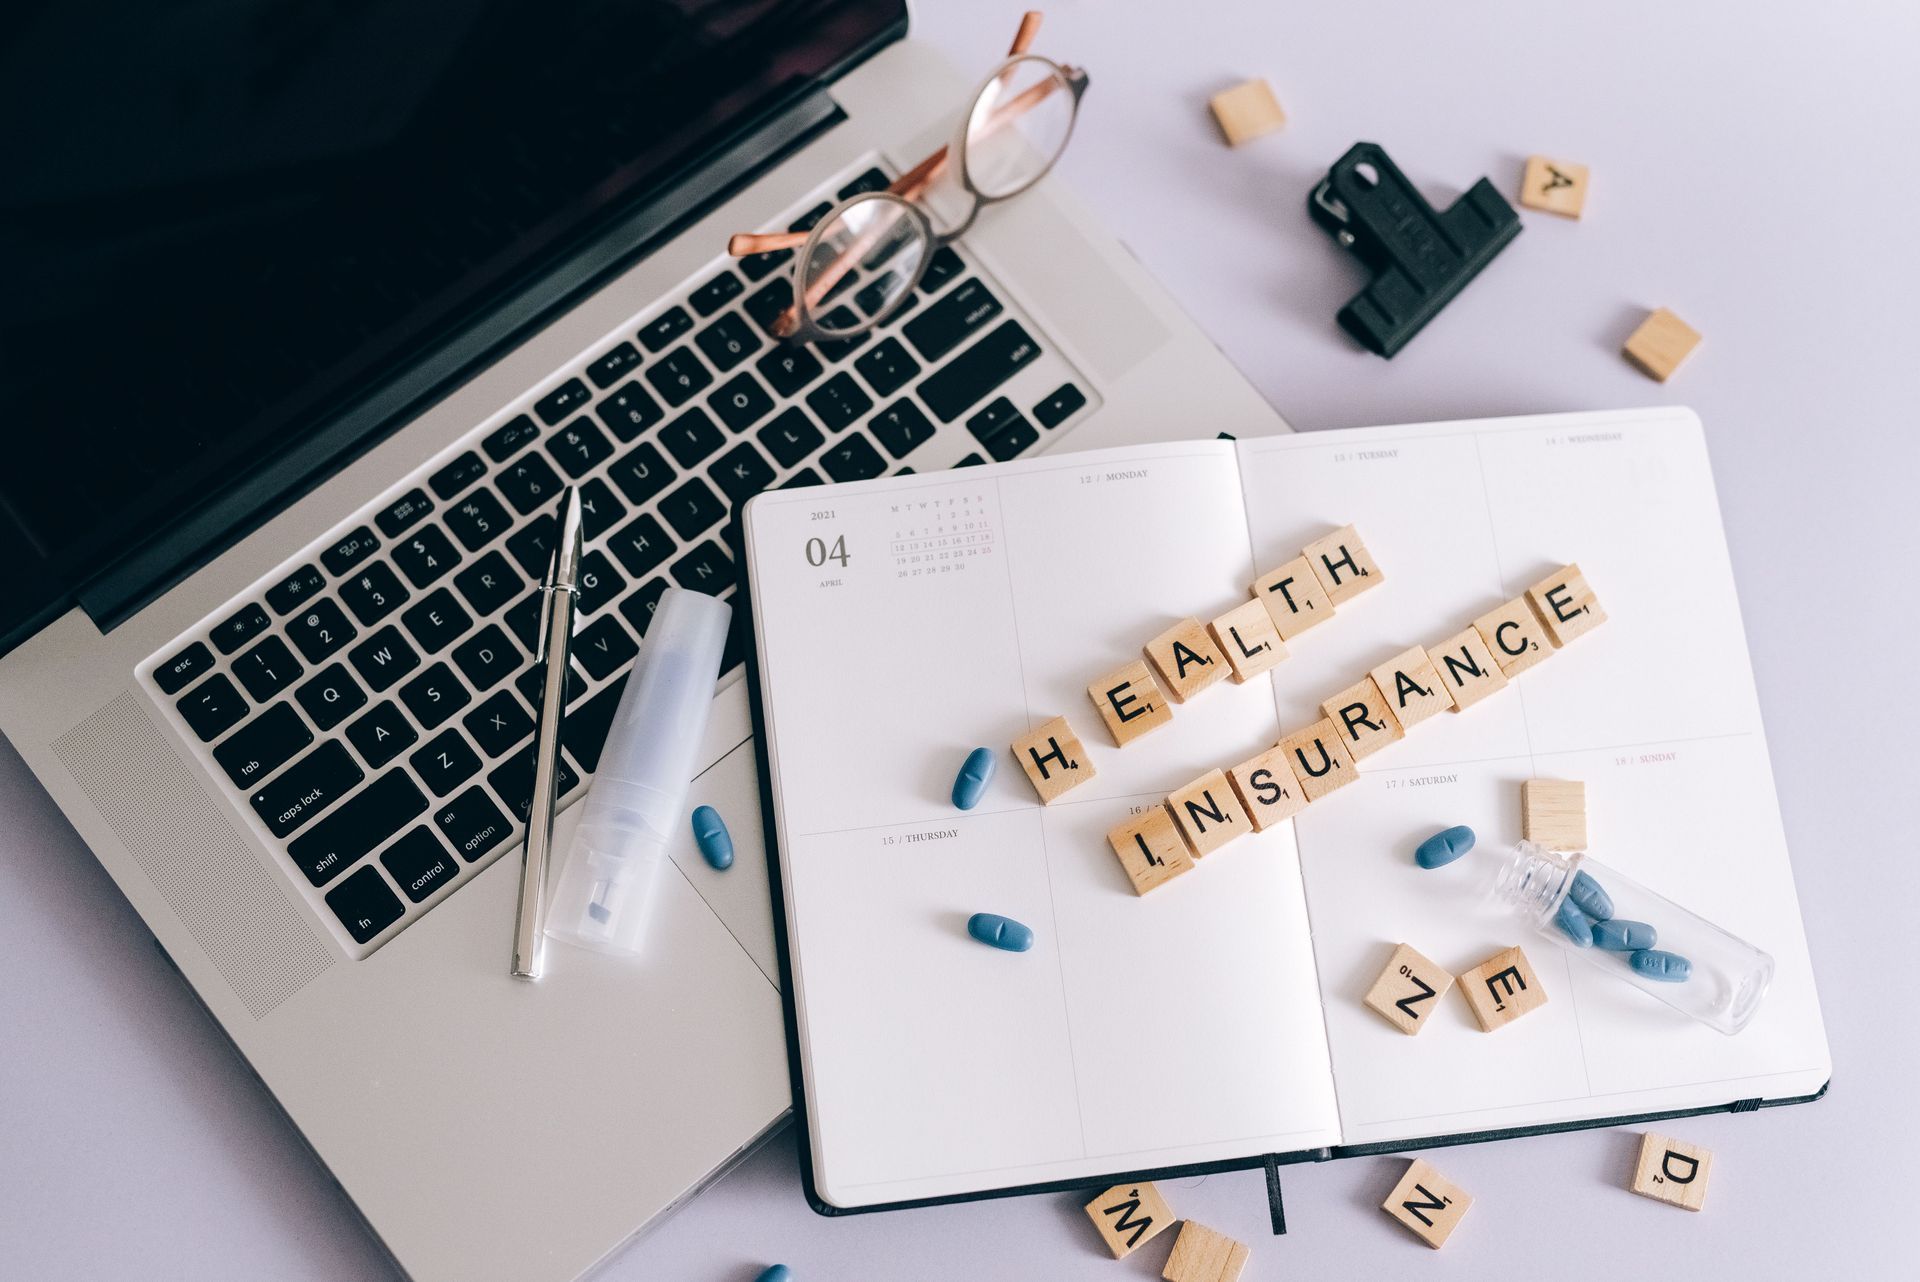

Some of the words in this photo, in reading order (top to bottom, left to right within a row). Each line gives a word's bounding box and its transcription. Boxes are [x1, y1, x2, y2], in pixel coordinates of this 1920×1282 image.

[1542, 165, 1573, 193] A
[782, 359, 794, 372] P
[679, 375, 690, 385] 9
[733, 393, 749, 408] O
[630, 411, 642, 423] 8
[567, 432, 580, 445] &
[783, 431, 799, 443] L
[578, 445, 589, 458] 7
[1357, 449, 1398, 460] TUESDAY
[633, 462, 649, 479] U
[734, 464, 749, 478] K
[1080, 475, 1092, 485] 12
[1106, 469, 1148, 481] MONDAY
[530, 482, 541, 494] 6
[463, 503, 479, 517] %
[583, 500, 596, 514] Y
[688, 501, 698, 515] J
[811, 510, 836, 521] 2021
[477, 518, 489, 532] 5
[413, 540, 425, 554] $
[532, 537, 545, 550] T
[632, 535, 650, 552] H
[805, 534, 851, 568] 04
[427, 555, 438, 567] 4
[696, 562, 713, 578] N
[362, 577, 372, 590] #
[481, 574, 496, 589] R
[583, 573, 598, 588] G
[819, 578, 843, 588] APRIL
[372, 592, 385, 606] 3
[307, 614, 320, 627] @
[429, 611, 443, 626] E
[319, 629, 333, 644] 2
[594, 637, 608, 652] V
[372, 646, 392, 666] W
[478, 648, 494, 664] D
[173, 656, 192, 673] esc
[265, 669, 277, 681] 1
[323, 687, 341, 703] Q
[427, 687, 441, 702] S
[490, 713, 507, 731] X
[375, 726, 390, 742] A
[437, 752, 454, 769] Z
[1639, 752, 1676, 764] SUNDAY
[241, 761, 260, 776] tab
[1386, 779, 1397, 789] 17
[1409, 774, 1457, 787] SATURDAY
[279, 803, 302, 823] caps
[300, 788, 323, 806] lock
[1129, 806, 1142, 815] 16
[444, 812, 456, 824] alt
[465, 825, 495, 850] option
[883, 836, 895, 846] 15
[906, 829, 958, 843] THURSDAY
[315, 852, 338, 873] shift
[411, 861, 445, 890] control
[358, 918, 372, 929] fn
[1486, 965, 1527, 1003] E
[1395, 976, 1436, 1020] Z
[1662, 1149, 1699, 1184] D
[1402, 1183, 1447, 1228] N
